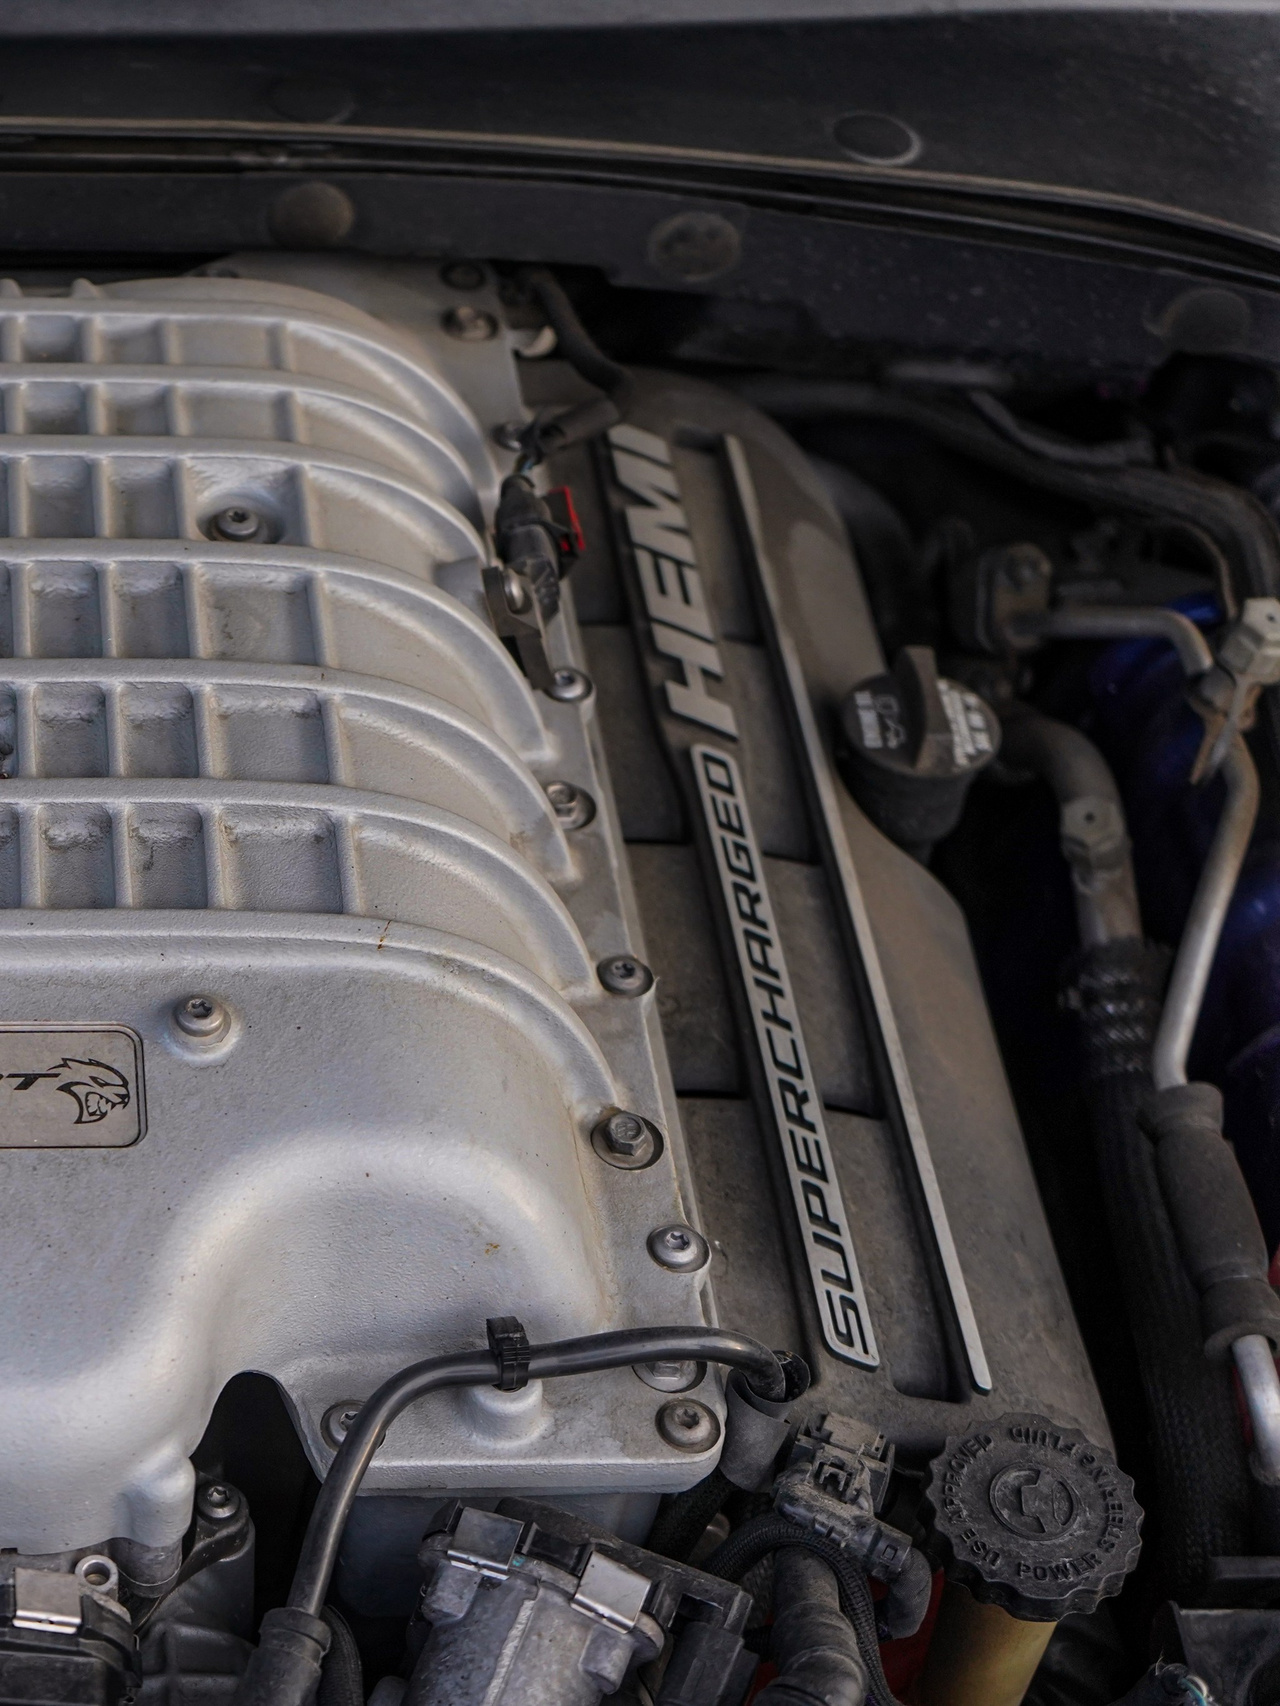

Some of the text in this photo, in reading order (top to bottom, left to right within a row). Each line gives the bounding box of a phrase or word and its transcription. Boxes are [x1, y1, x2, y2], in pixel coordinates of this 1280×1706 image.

[607, 423, 740, 741] HEMI
[700, 751, 873, 1356] SUPERCHARGED
[942, 1433, 1001, 1567] USE APPROVED
[1008, 1426, 1124, 1582] POWER STEERING FLUID
